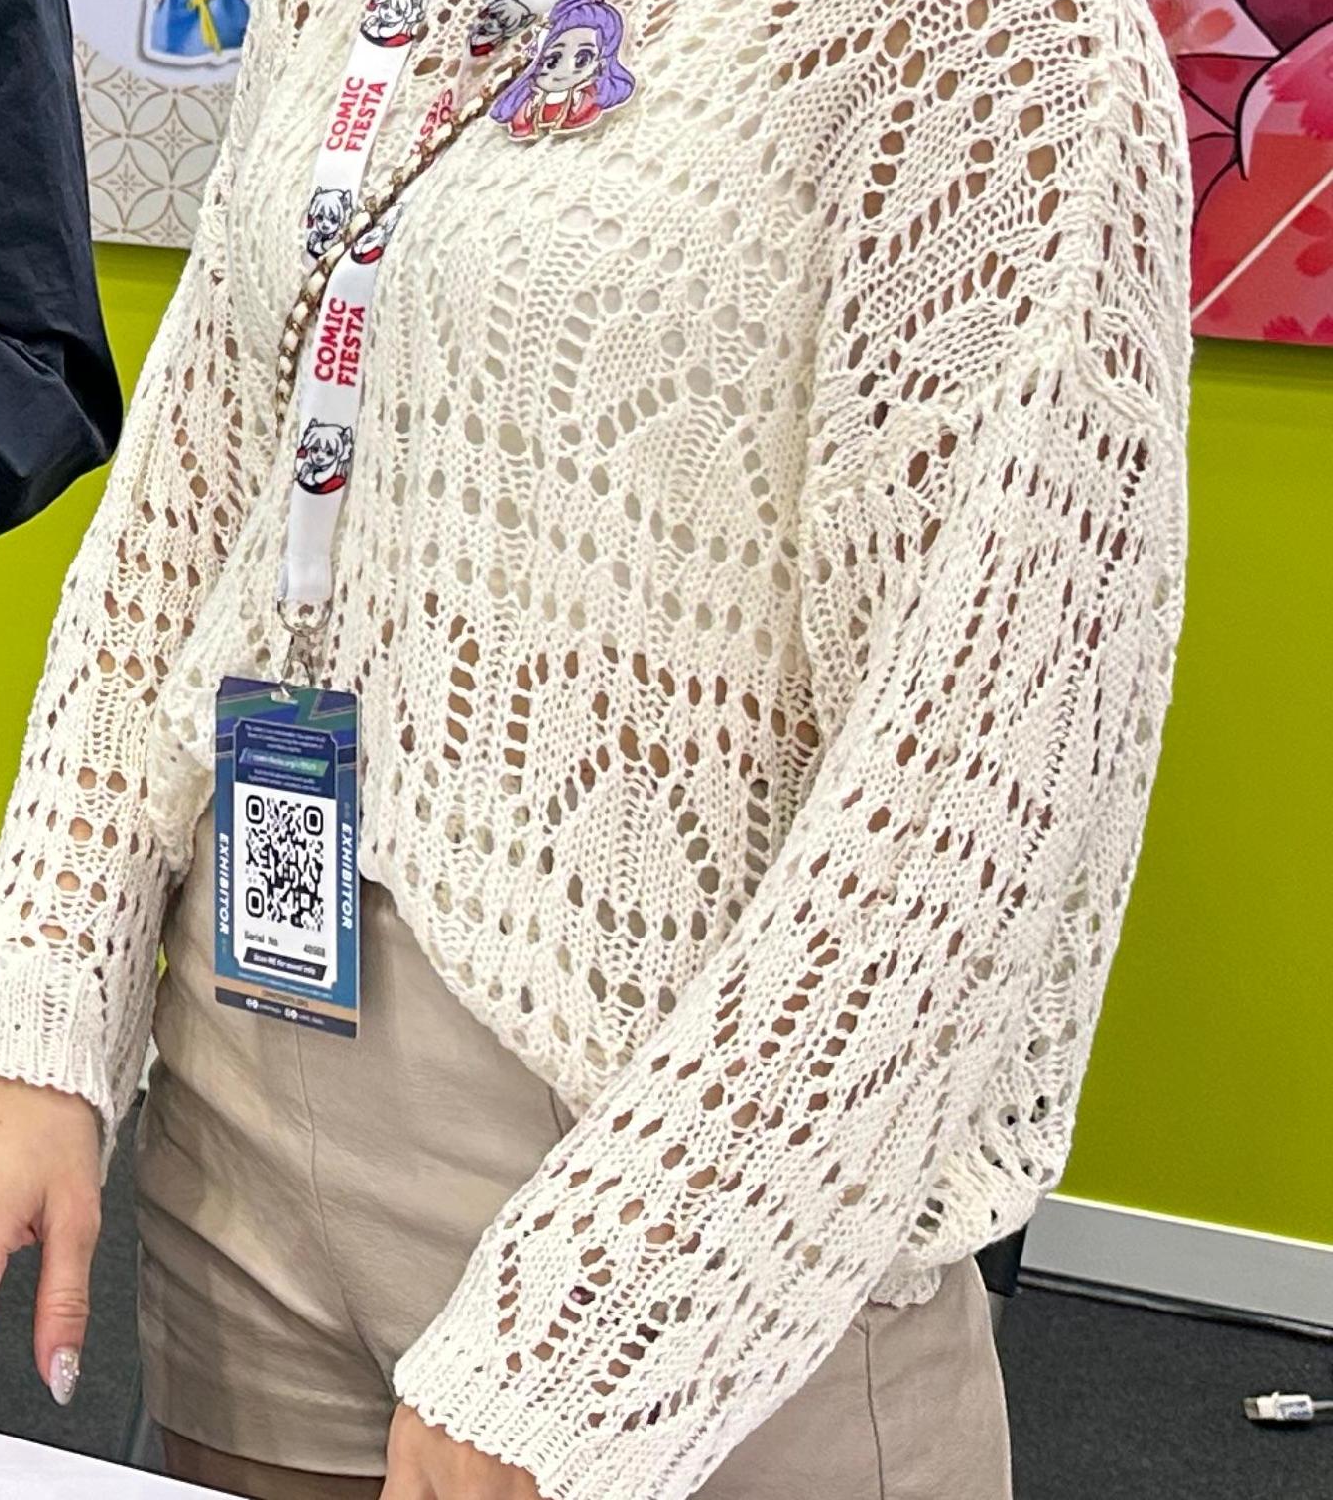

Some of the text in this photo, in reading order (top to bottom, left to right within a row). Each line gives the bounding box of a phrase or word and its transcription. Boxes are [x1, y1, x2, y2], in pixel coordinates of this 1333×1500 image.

[326, 76, 364, 151] COMIC
[344, 80, 388, 152] FIESTA
[314, 297, 347, 382] COMIC
[337, 305, 365, 387] FIESTA
[219, 832, 230, 935] EXHIBITOR
[341, 822, 353, 930] EXHIBITOR
